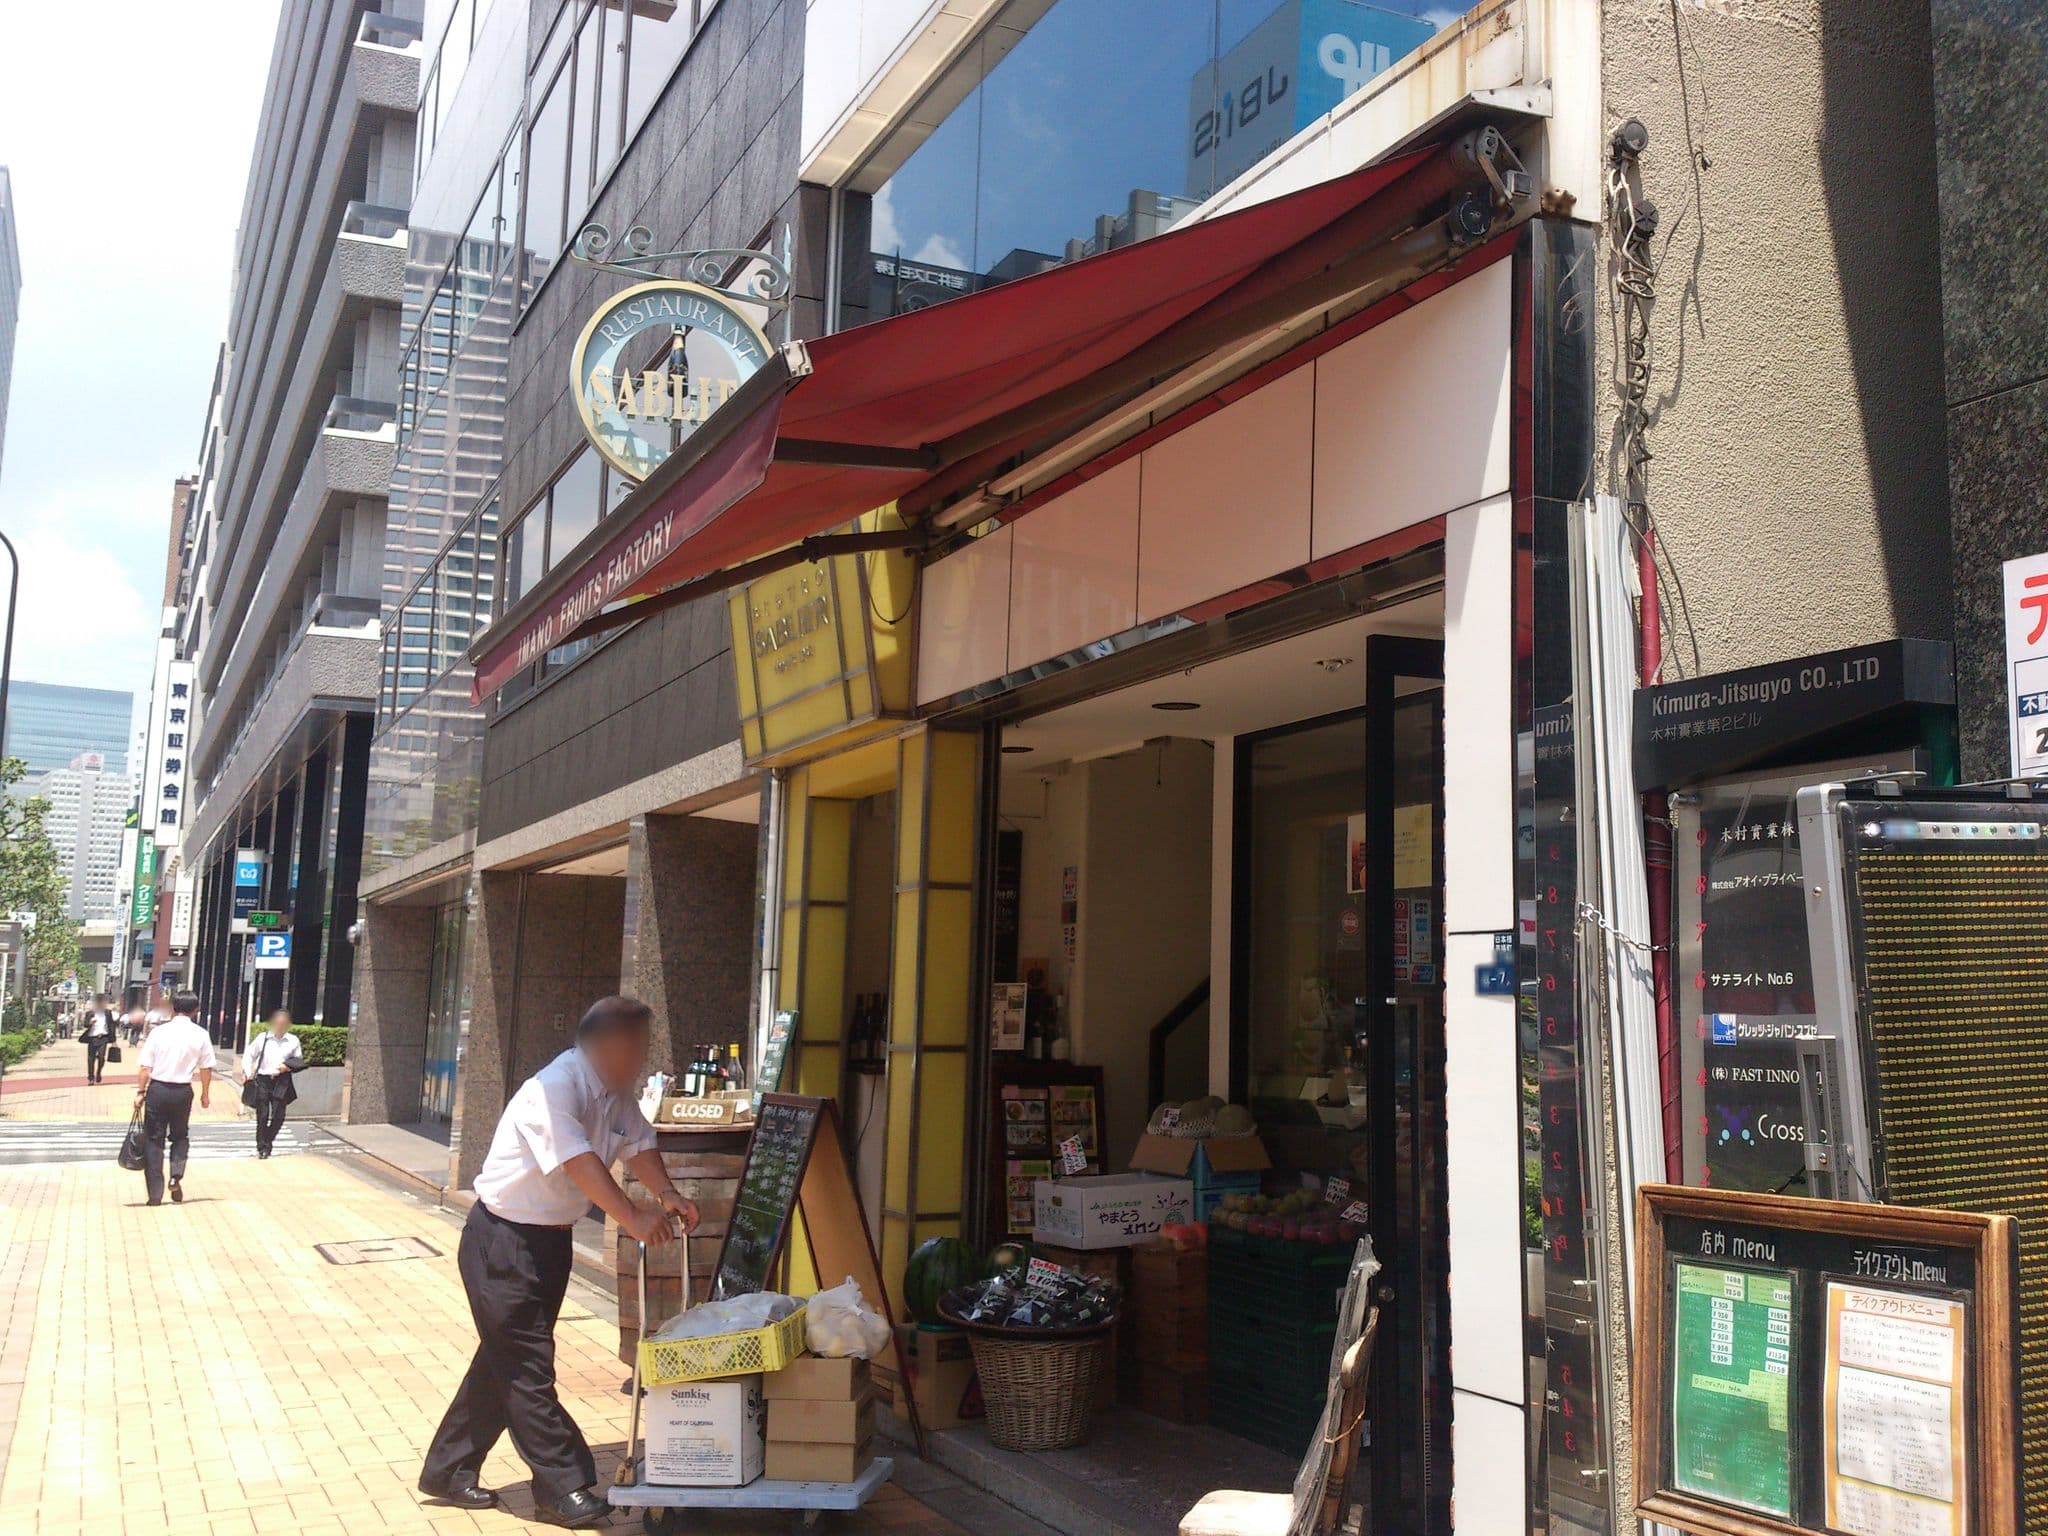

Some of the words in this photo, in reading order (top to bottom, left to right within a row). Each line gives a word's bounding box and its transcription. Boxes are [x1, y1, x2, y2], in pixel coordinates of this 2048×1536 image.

[599, 295, 760, 360] RESTAURANT
[516, 616, 553, 668] IMANO
[559, 571, 603, 635] FRUITS
[606, 510, 675, 594] FACTORY
[1651, 674, 1792, 717] Kimura-Jitsugyo
[1799, 656, 1881, 692] CO.,LTD
[160, 683, 188, 824] 東京証券会館
[1696, 828, 1708, 849] 9
[1695, 875, 1707, 895] 8
[136, 884, 151, 924] クリニック
[1695, 923, 1708, 942] 7
[262, 936, 286, 956] P
[1694, 970, 1706, 991] 6
[1710, 973, 1764, 987] サテライト
[1767, 972, 1794, 986] No.6
[1696, 1067, 1708, 1088] 4
[1732, 1068, 1764, 1083] FAST
[672, 1103, 724, 1119] CLOSED
[1697, 1116, 1709, 1137] 3
[1700, 1165, 1711, 1187] 2
[1099, 1210, 1140, 1224] やまとう
[1700, 1229, 1726, 1255] 店内
[1850, 1294, 1945, 1317] テイクアウトメニュー
[671, 1388, 711, 1402] Sunkist
